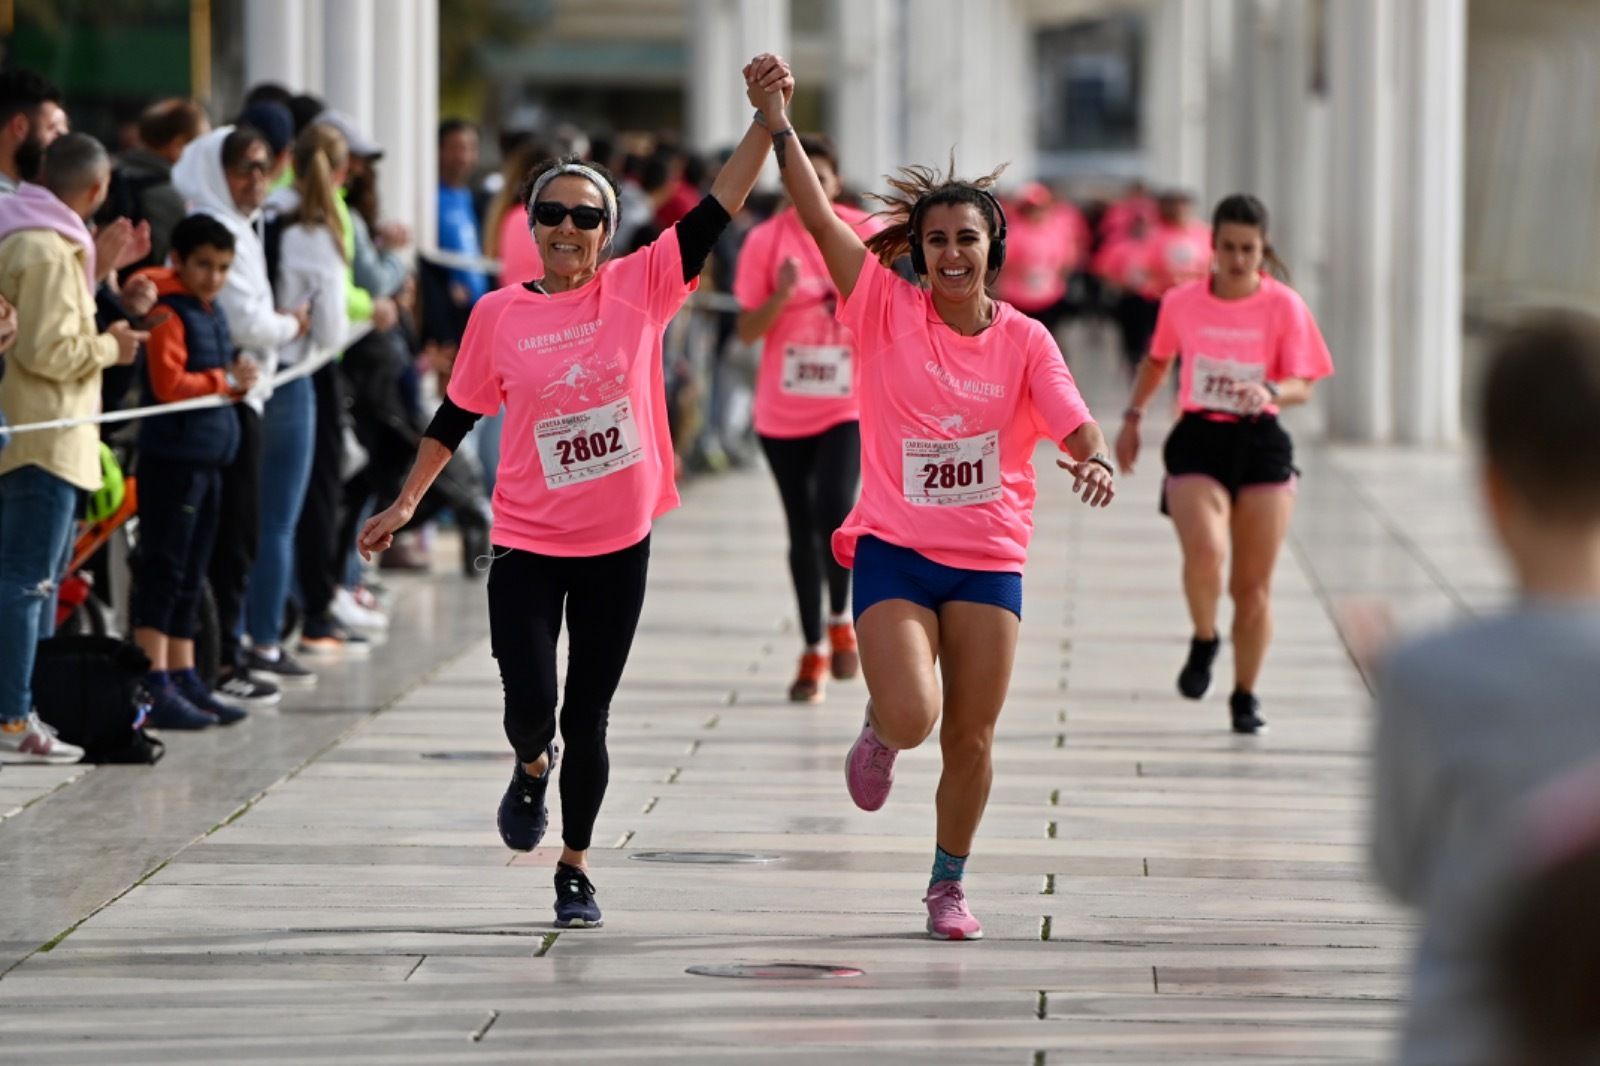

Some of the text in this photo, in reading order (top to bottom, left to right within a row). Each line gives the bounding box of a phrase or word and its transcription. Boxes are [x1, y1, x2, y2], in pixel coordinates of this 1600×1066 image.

[517, 332, 562, 352] CARRERA
[963, 379, 1005, 399] MUJERES
[556, 426, 623, 466] 2802
[923, 458, 984, 489] 2801
